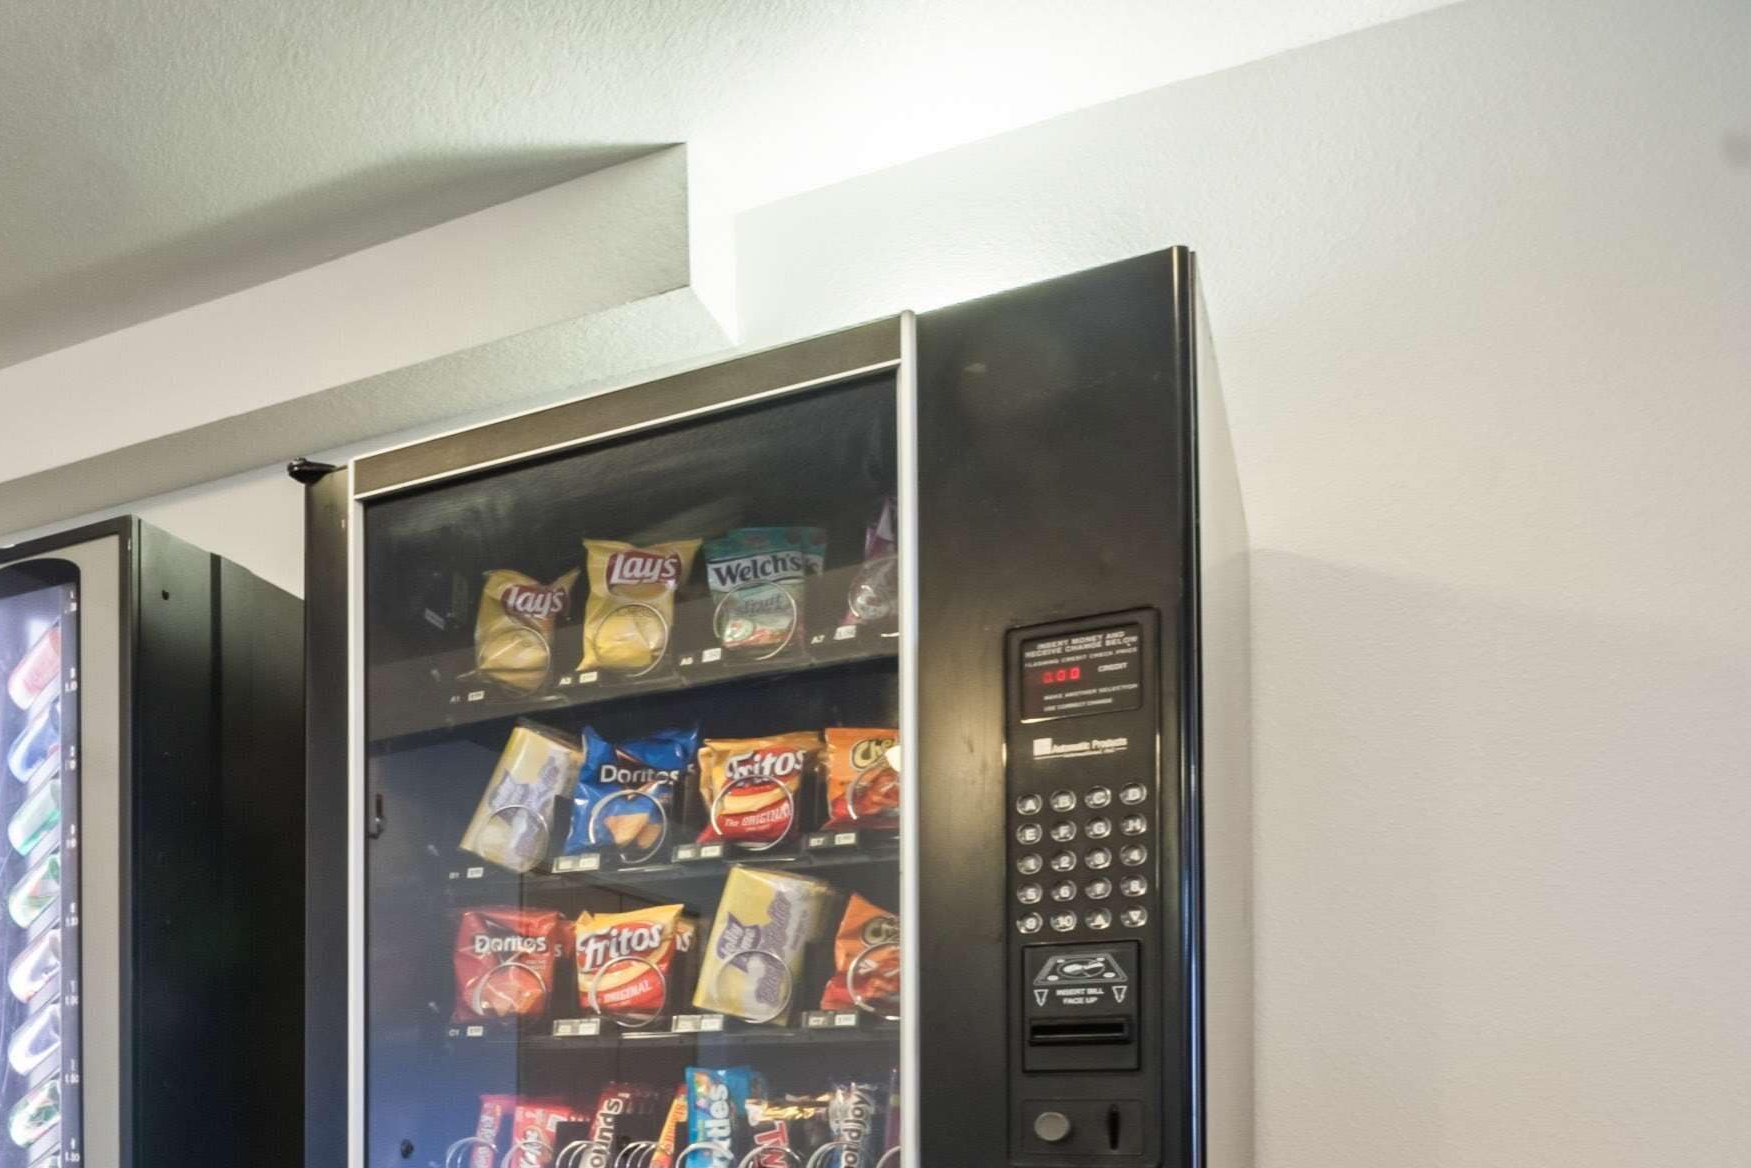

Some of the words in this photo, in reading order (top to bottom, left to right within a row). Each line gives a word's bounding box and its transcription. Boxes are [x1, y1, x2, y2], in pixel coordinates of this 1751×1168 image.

[610, 553, 678, 585] Lay's
[712, 554, 800, 586] Welch's
[1071, 634, 1103, 645] MONEY
[1105, 631, 1125, 640] AND
[1097, 662, 1128, 672] CREDIT
[600, 764, 681, 785] Doritos
[725, 751, 807, 785] Fritos
[474, 934, 547, 954] Doritos
[578, 923, 664, 973] Fritos
